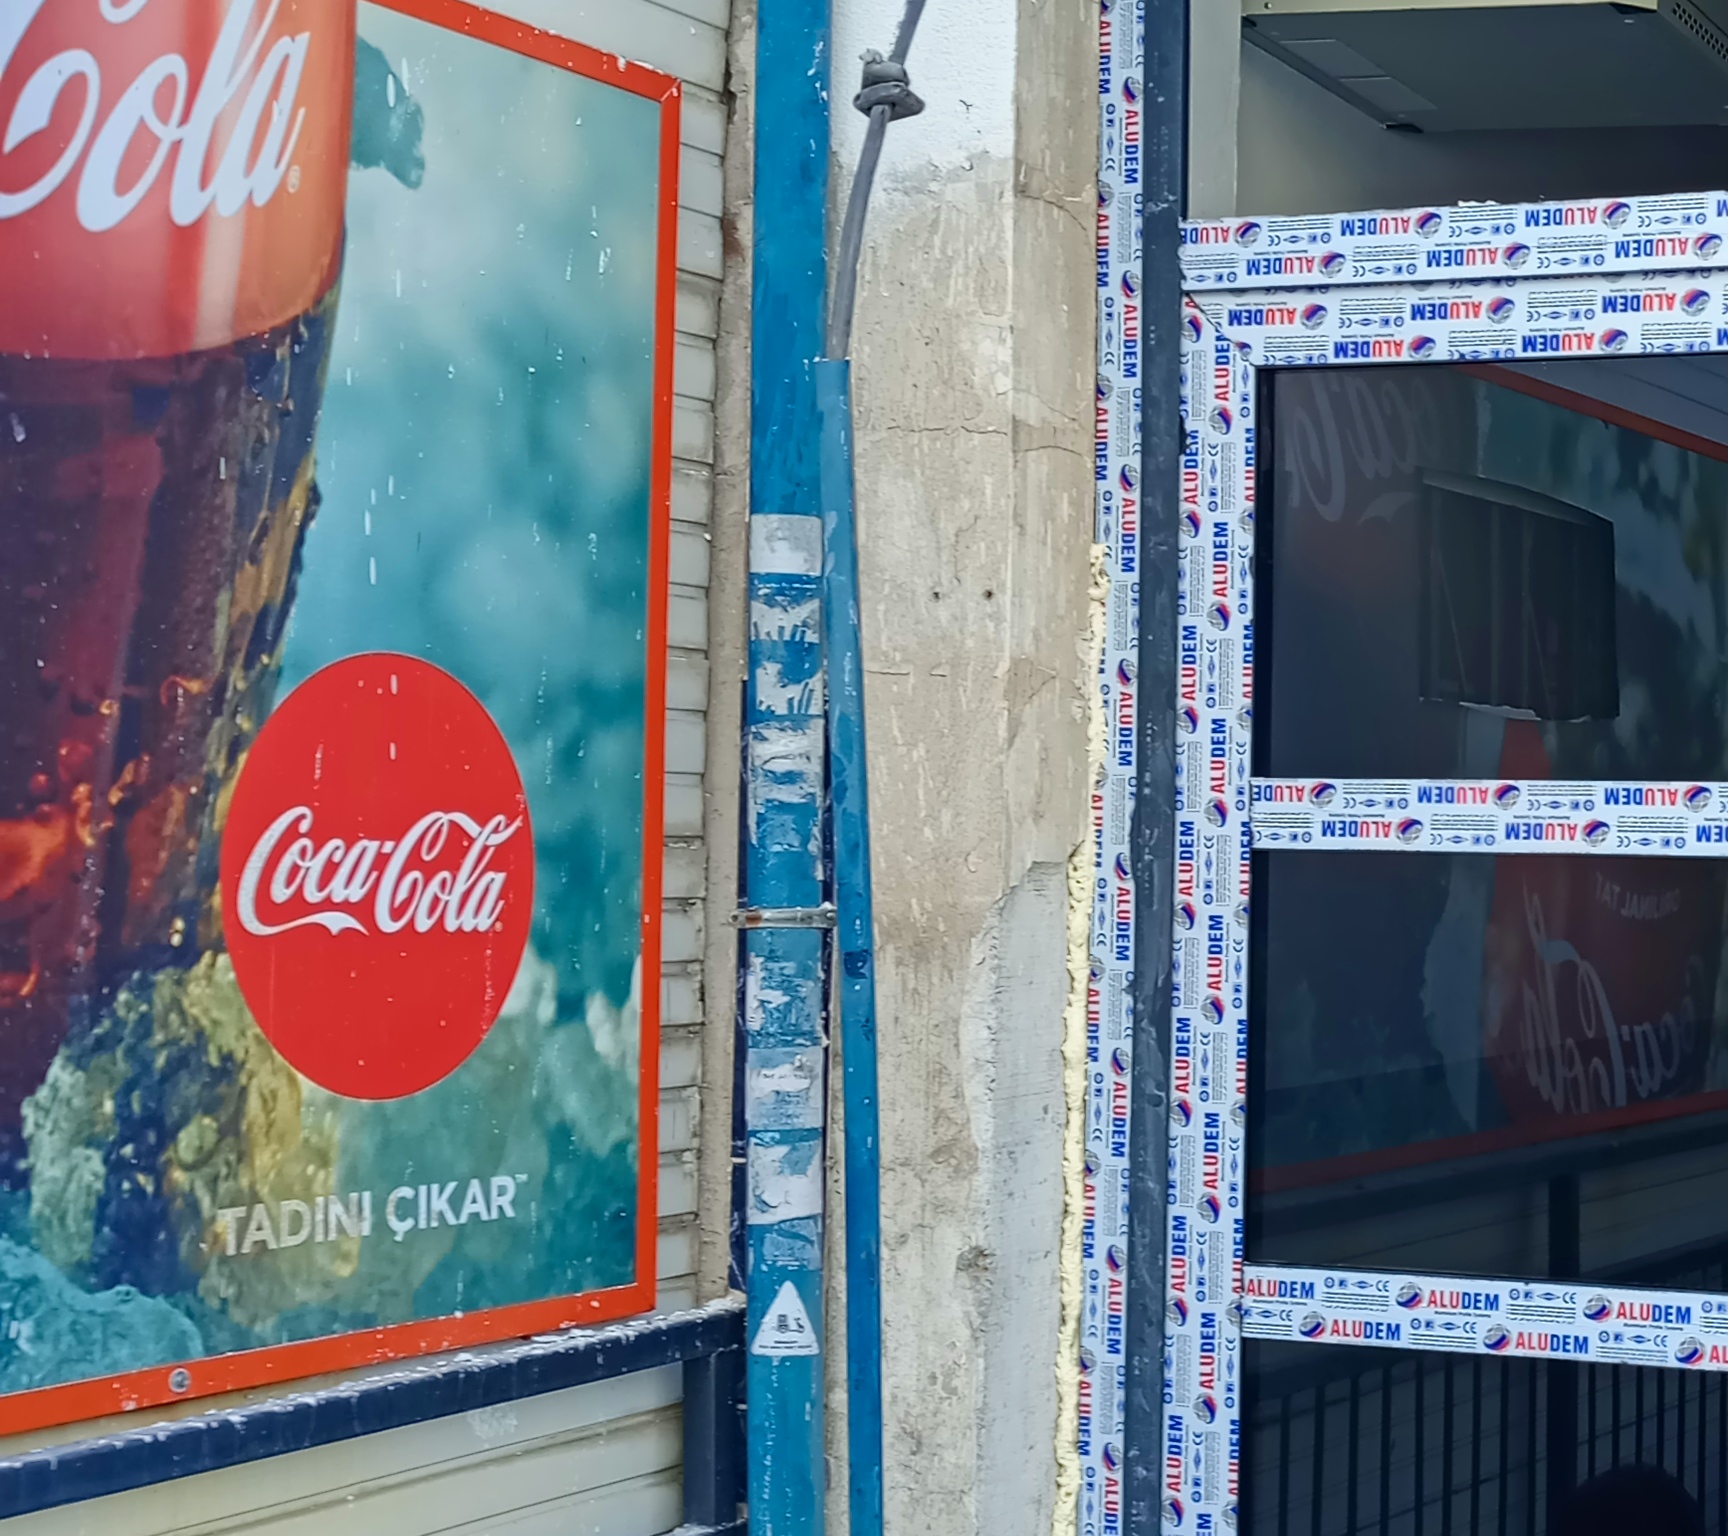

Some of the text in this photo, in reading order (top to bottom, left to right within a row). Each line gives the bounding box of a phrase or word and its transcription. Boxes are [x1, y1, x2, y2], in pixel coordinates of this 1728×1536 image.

[1125, 109, 1141, 184] ALUDEM
[1341, 216, 1411, 235] ALUDEM
[1525, 206, 1598, 227] ALUDEM
[1181, 226, 1231, 244] ALUDE
[1427, 247, 1499, 266] ALUDEM
[1615, 237, 1689, 258] ALUDEM
[1246, 256, 1315, 275] ALUDEM
[1410, 301, 1483, 320] ALUDEM
[1602, 293, 1677, 313] ALUDEM
[1228, 307, 1297, 327] ALUDEM
[1123, 303, 1140, 378] ALUDEM
[1334, 339, 1405, 359] ALUDEM
[1521, 332, 1595, 354] ALUDEM
[1121, 497, 1136, 573] ALUDEM
[1213, 522, 1228, 597] ALUDEM
[1181, 625, 1197, 701] ALUDEM
[1119, 691, 1135, 767] ALUDEM
[1210, 718, 1226, 794] ALUDEM
[1252, 784, 1305, 803] ALUDE
[1417, 785, 1489, 804] ALUDEM
[1604, 786, 1678, 807] ALUDEM
[1321, 819, 1393, 839] ALUDEM
[1505, 821, 1579, 841] ALUDEM
[1178, 821, 1194, 897] ALUDEM
[1116, 886, 1132, 961] ALUDEM
[1208, 915, 1223, 991] ALUDEM
[1175, 1018, 1190, 1094] ALUDEM
[1112, 1081, 1128, 1157] ALUDEM
[1203, 1113, 1219, 1190] ALUDEM
[219, 1176, 516, 1256] TADINI ÇIKAR
[1170, 1216, 1187, 1293] ALUDEM
[1247, 1278, 1316, 1300] ALUDEM
[1427, 1289, 1500, 1311] ALUDEM
[1108, 1278, 1124, 1355] ALUDEM
[1616, 1301, 1691, 1324] ALUDEM
[1330, 1319, 1401, 1341] ALUDEM
[1199, 1313, 1215, 1390] ALUDEM
[1516, 1331, 1589, 1354] ALUDEM
[1166, 1415, 1182, 1492] ALUDEM
